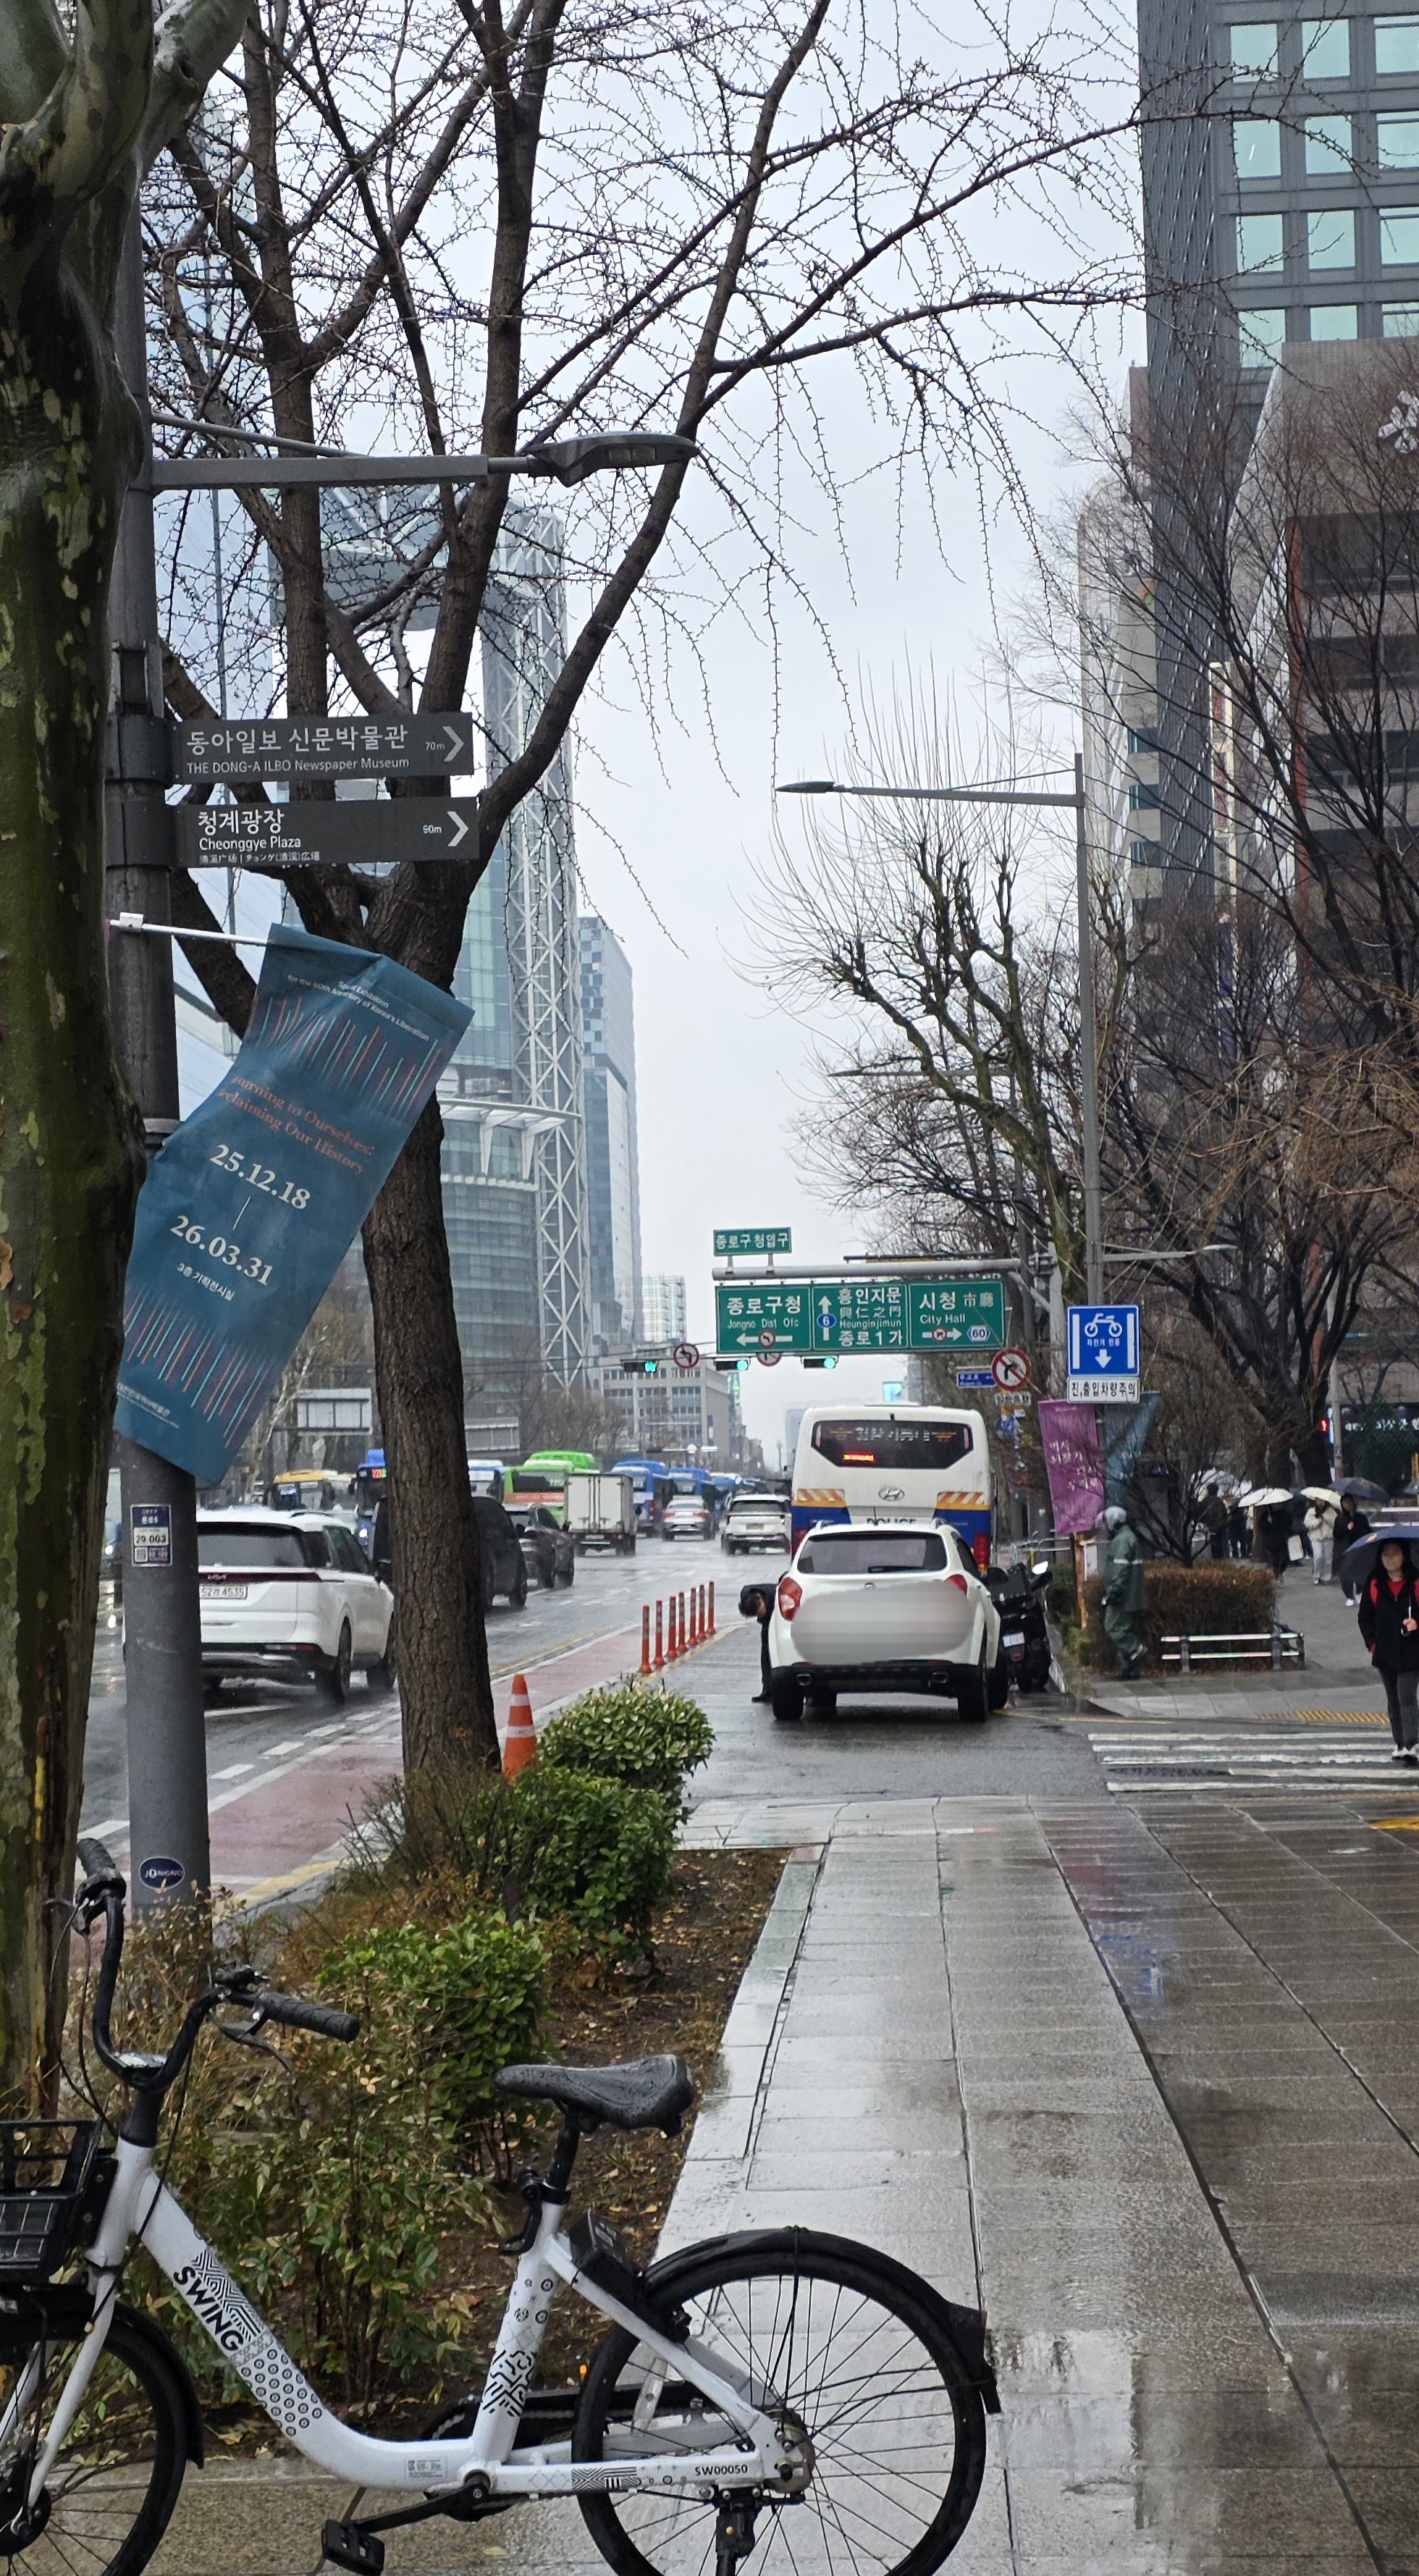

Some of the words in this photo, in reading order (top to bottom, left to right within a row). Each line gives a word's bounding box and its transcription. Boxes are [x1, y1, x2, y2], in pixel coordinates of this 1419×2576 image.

[187, 728, 282, 756] 동아일보
[289, 725, 409, 752] 신문박물관
[425, 741, 445, 752] 70m
[187, 762, 209, 774] THE
[213, 761, 261, 773] DONG-A
[264, 759, 291, 772] ILBO
[295, 759, 358, 773] Newspaper
[361, 758, 410, 770] Museum
[198, 809, 285, 836] 청계광장
[199, 838, 266, 852] Cheonggye
[270, 835, 301, 849] Plaza
[300, 978, 311, 987] the
[371, 1004, 396, 1023] Korea's
[395, 1018, 429, 1042] Liberation
[285, 1122, 313, 1145] Our
[315, 1137, 365, 1176] History
[210, 1144, 311, 1209] 25.12.18
[716, 1232, 788, 1250] 종로구청입구
[170, 1216, 273, 1286] 26.03.31
[177, 1263, 193, 1277] 3층
[838, 1286, 901, 1305] 흥인지문
[919, 1292, 956, 1310] 시청
[727, 1295, 801, 1316] 종로구청
[728, 1318, 756, 1331] Jongno
[762, 1318, 778, 1328] Dist
[823, 1316, 830, 1326] 6
[840, 1319, 902, 1330] Heunginjimun
[920, 1314, 942, 1326] City
[945, 1313, 966, 1323] Hall
[972, 1329, 985, 1338] 60
[1087, 1338, 1106, 1347] 자전거
[149, 1535, 166, 1544] 003
[174, 2266, 243, 2352] SWING
[695, 2464, 748, 2476] SW00050
